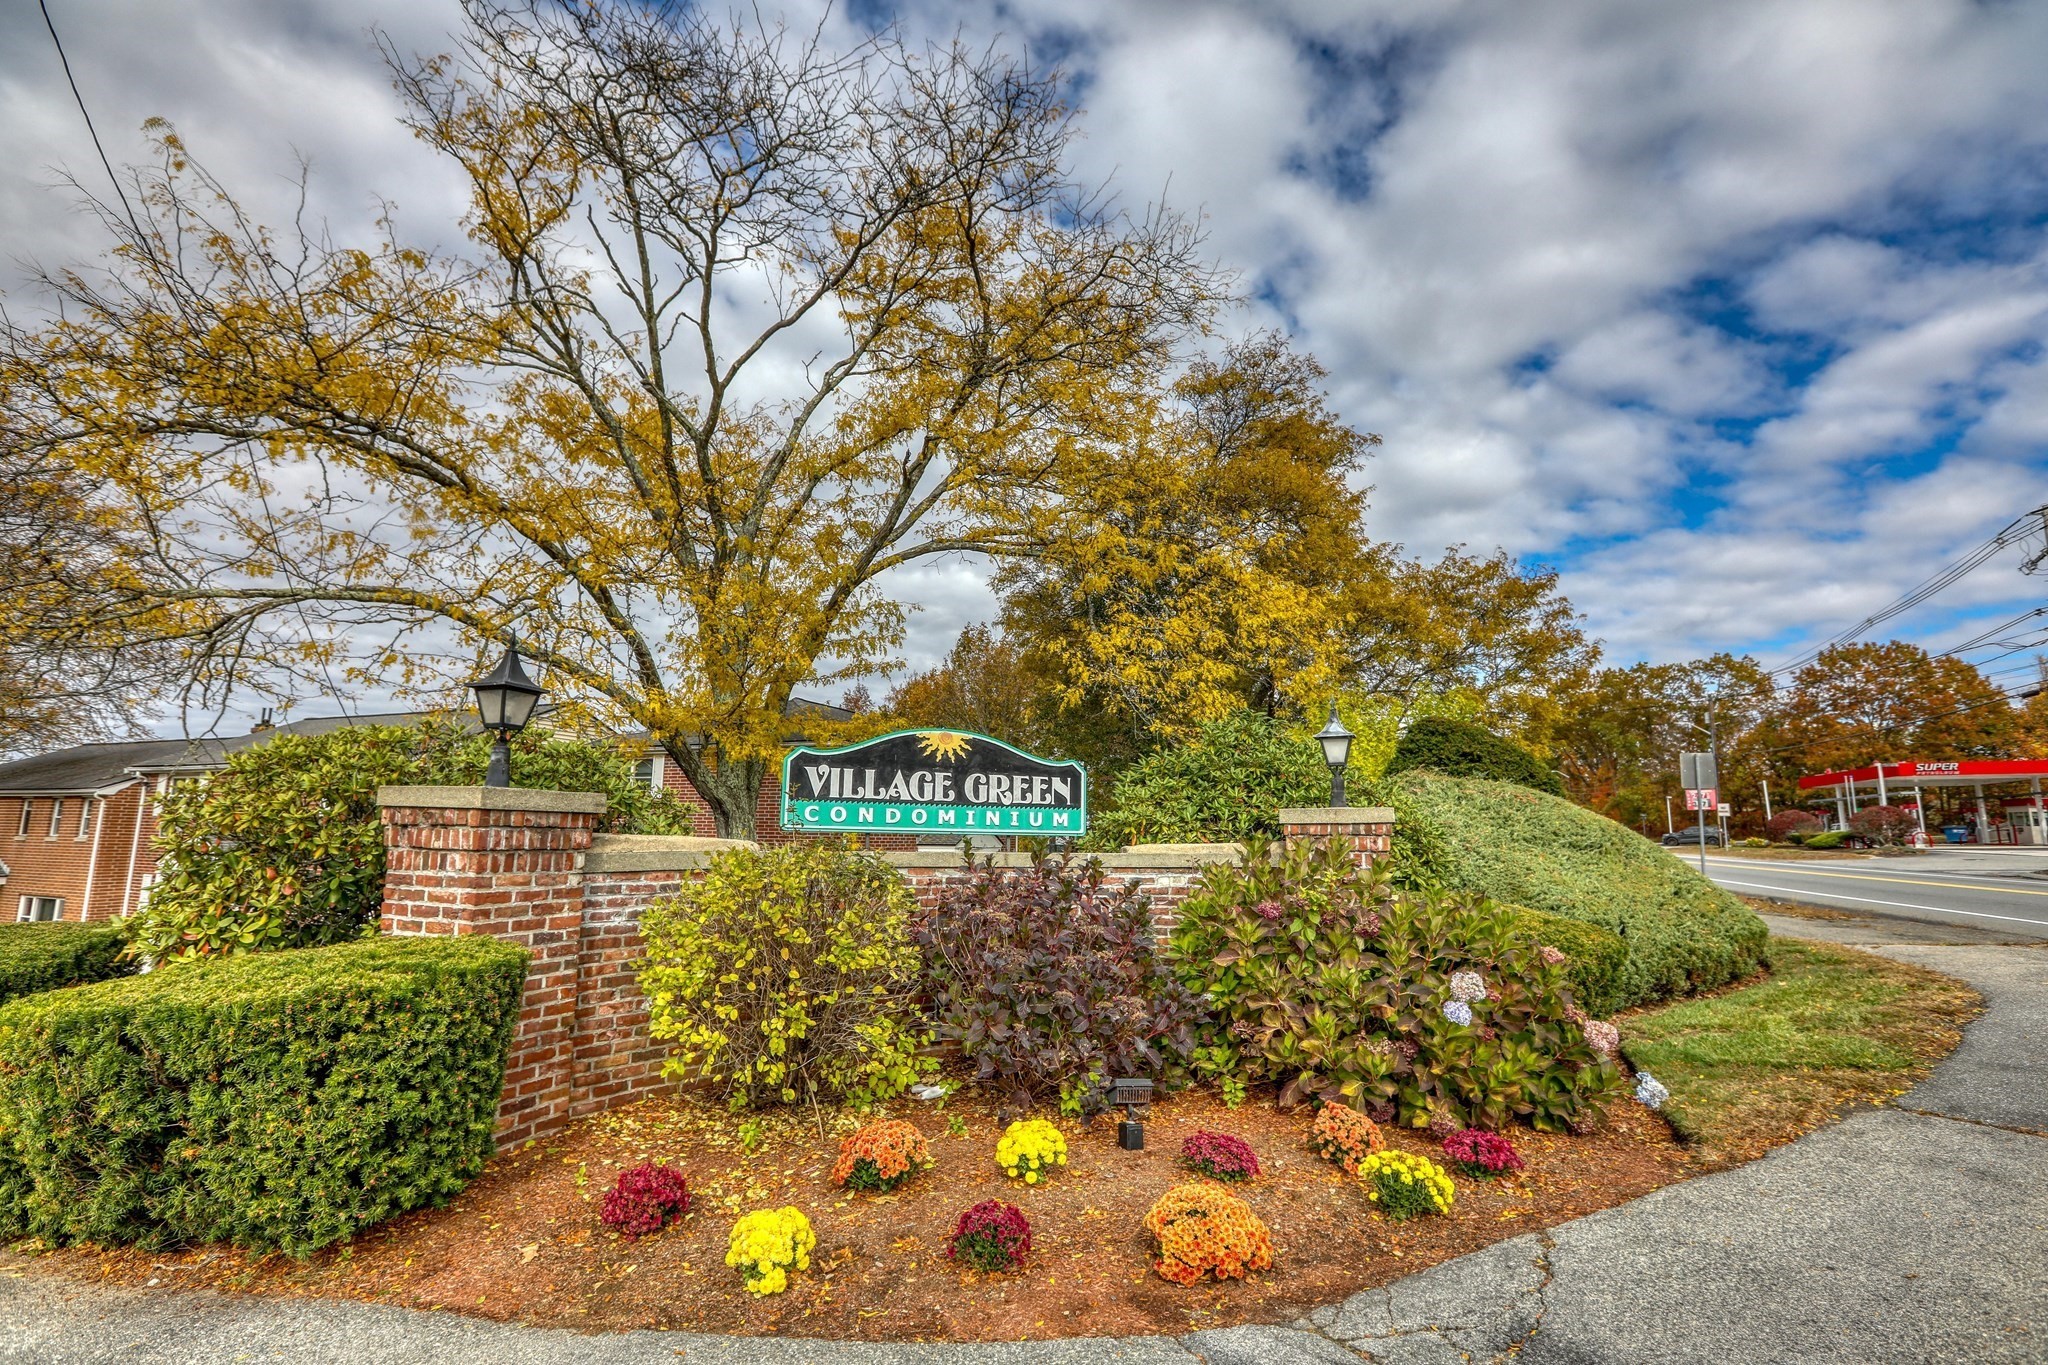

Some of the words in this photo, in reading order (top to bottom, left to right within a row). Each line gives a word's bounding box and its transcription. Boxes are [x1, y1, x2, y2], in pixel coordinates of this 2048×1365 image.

[1915, 762, 1959, 771] SUPER
[803, 764, 955, 802] VILLAGE
[964, 773, 1072, 806] GREEN
[804, 806, 1069, 827] CONDOMINIUM
